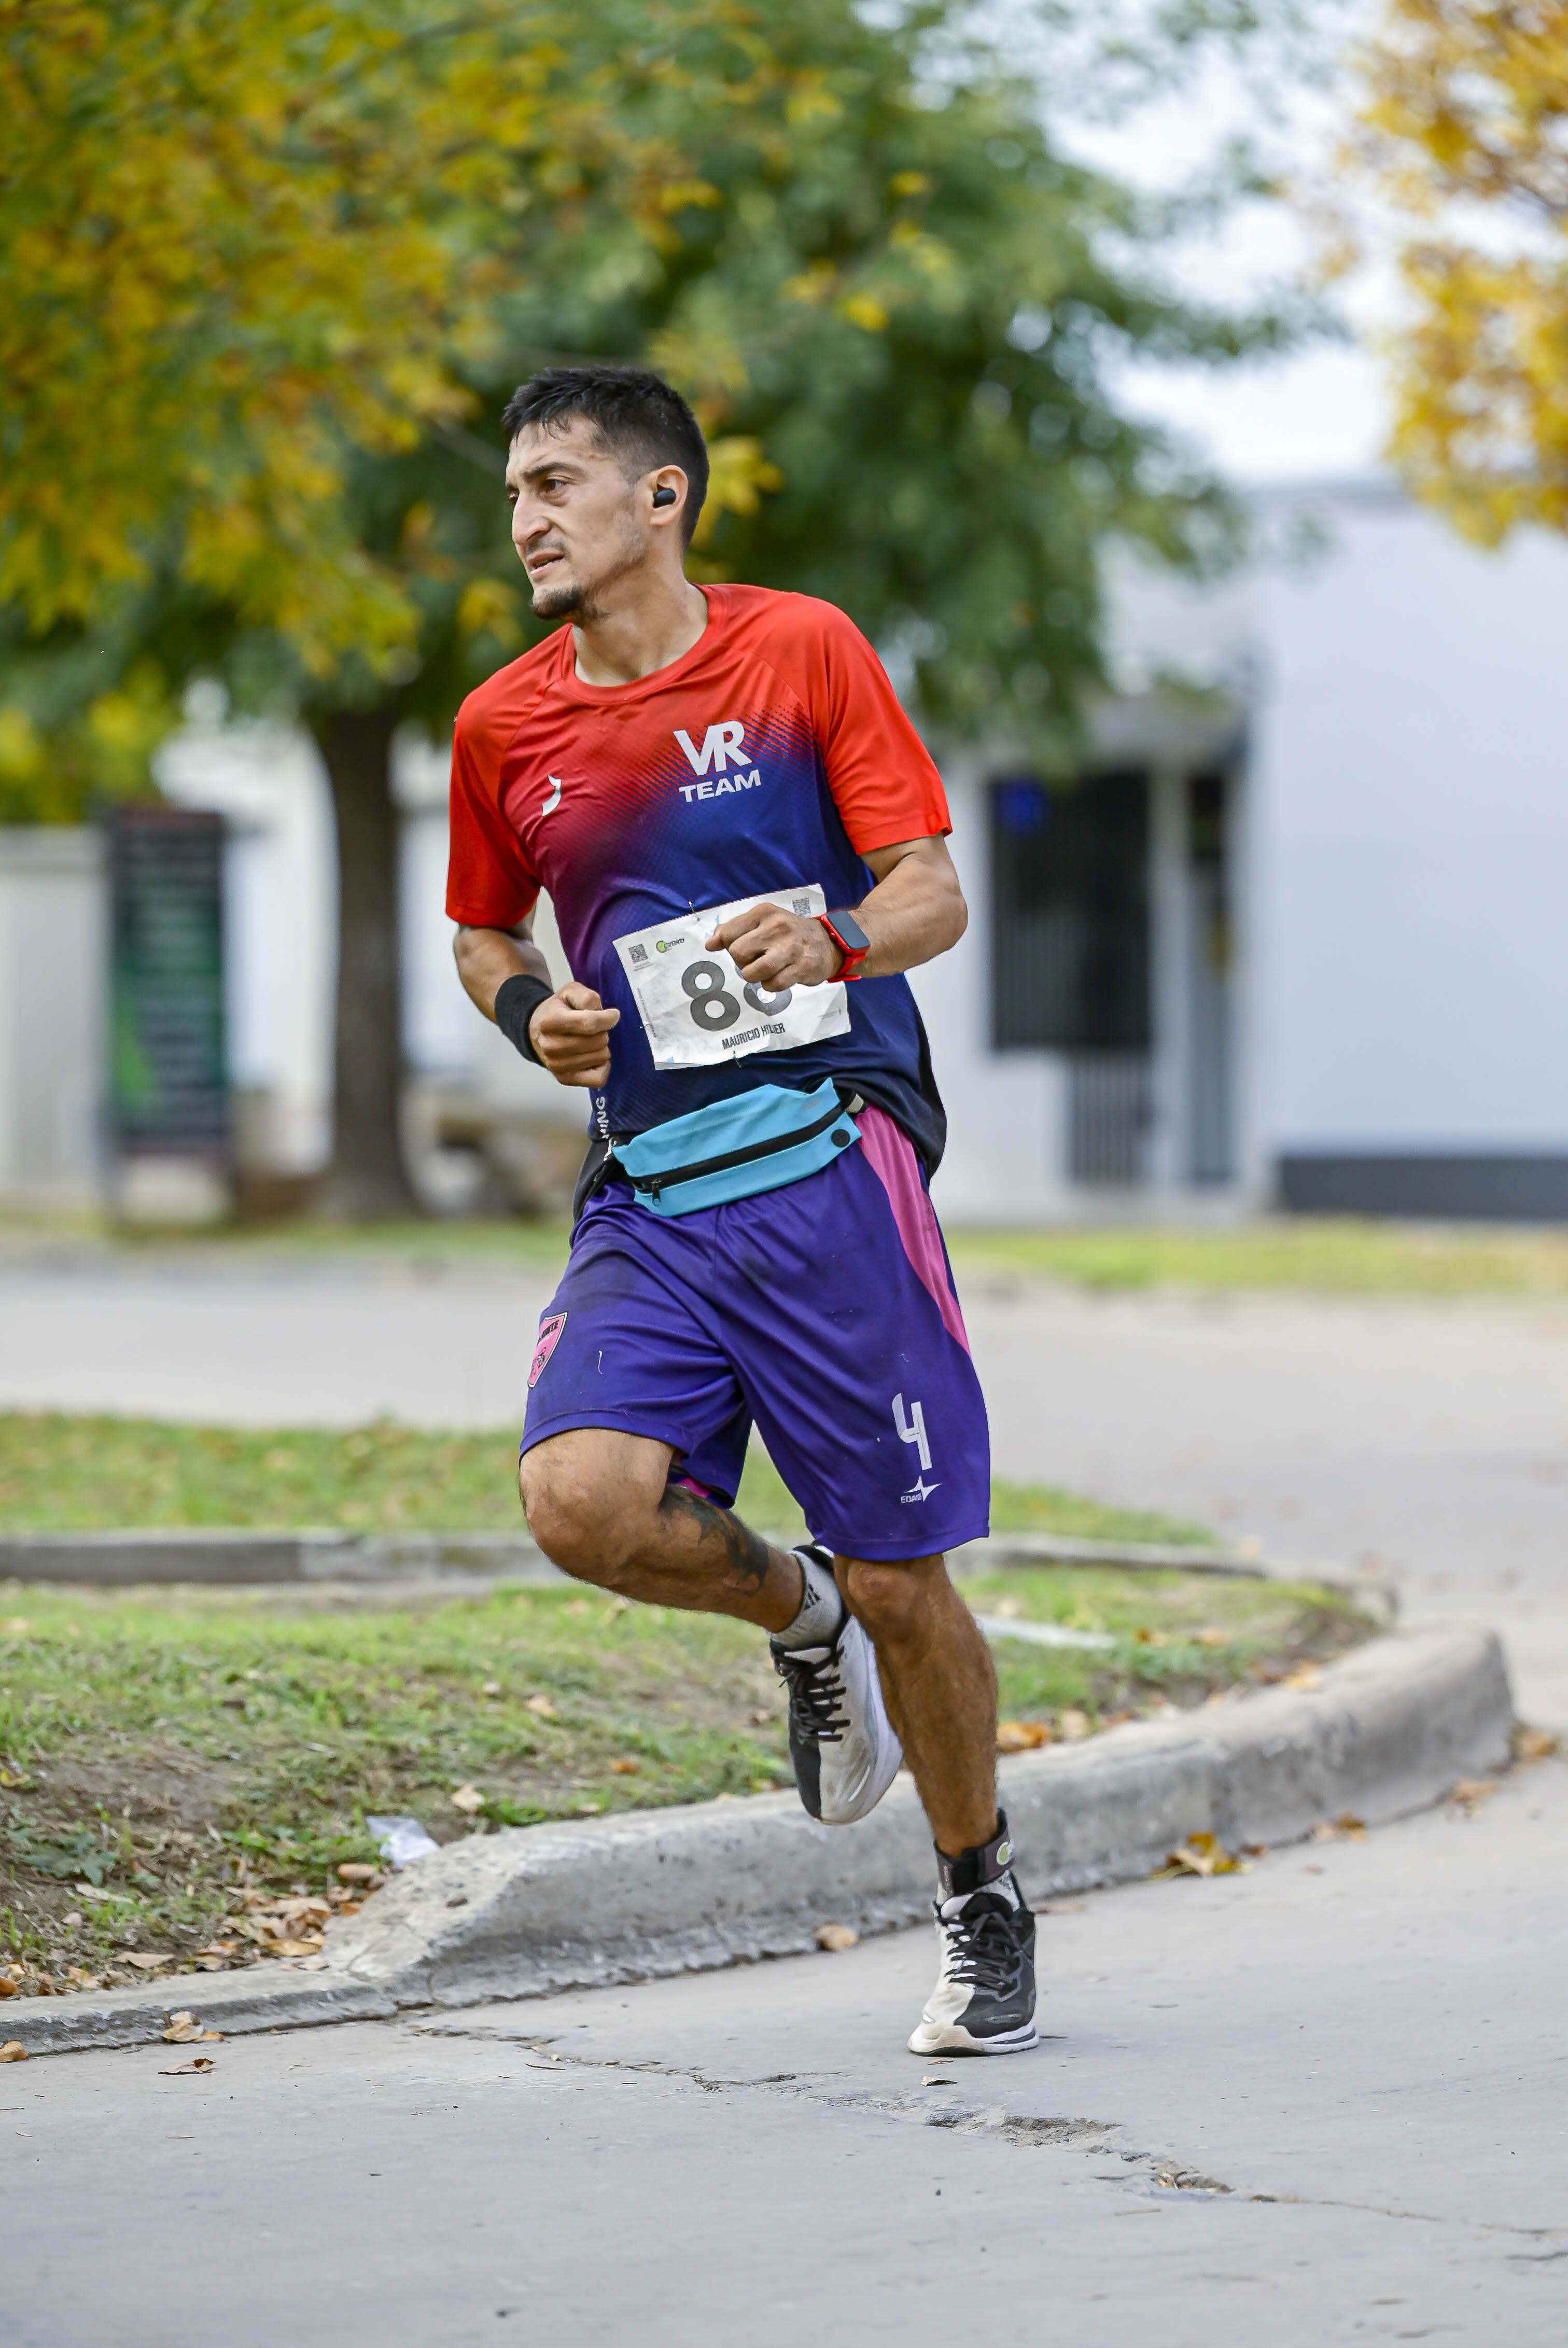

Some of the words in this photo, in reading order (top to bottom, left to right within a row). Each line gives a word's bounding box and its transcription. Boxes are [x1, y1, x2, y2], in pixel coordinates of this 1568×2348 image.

[673, 721, 752, 776] VR
[679, 769, 761, 802] TEAM
[721, 1027, 760, 1050] MAURICIO
[892, 1392, 932, 1470] 4
